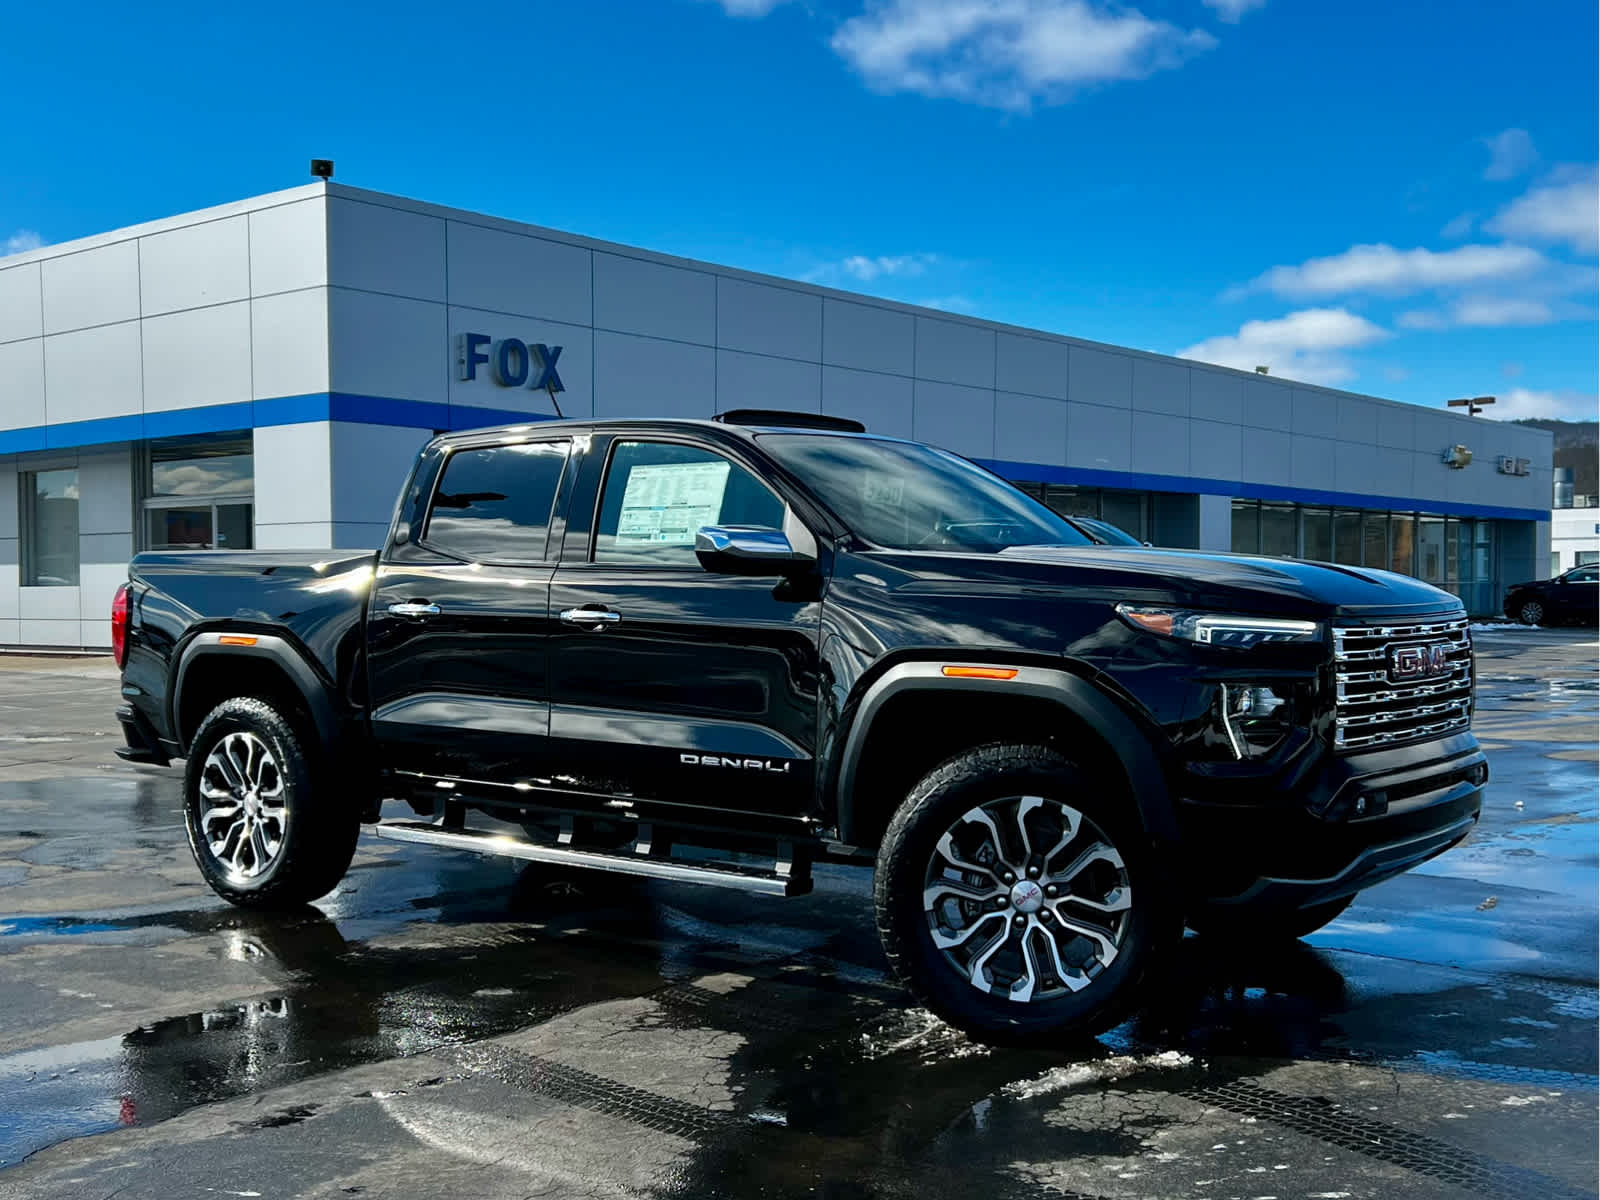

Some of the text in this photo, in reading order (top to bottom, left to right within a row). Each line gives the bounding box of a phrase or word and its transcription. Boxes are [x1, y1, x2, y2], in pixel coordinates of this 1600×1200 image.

[456, 332, 566, 392] FOX
[1393, 643, 1458, 679] GMC
[680, 754, 790, 773] DENALI
[1015, 887, 1039, 906] GMC
